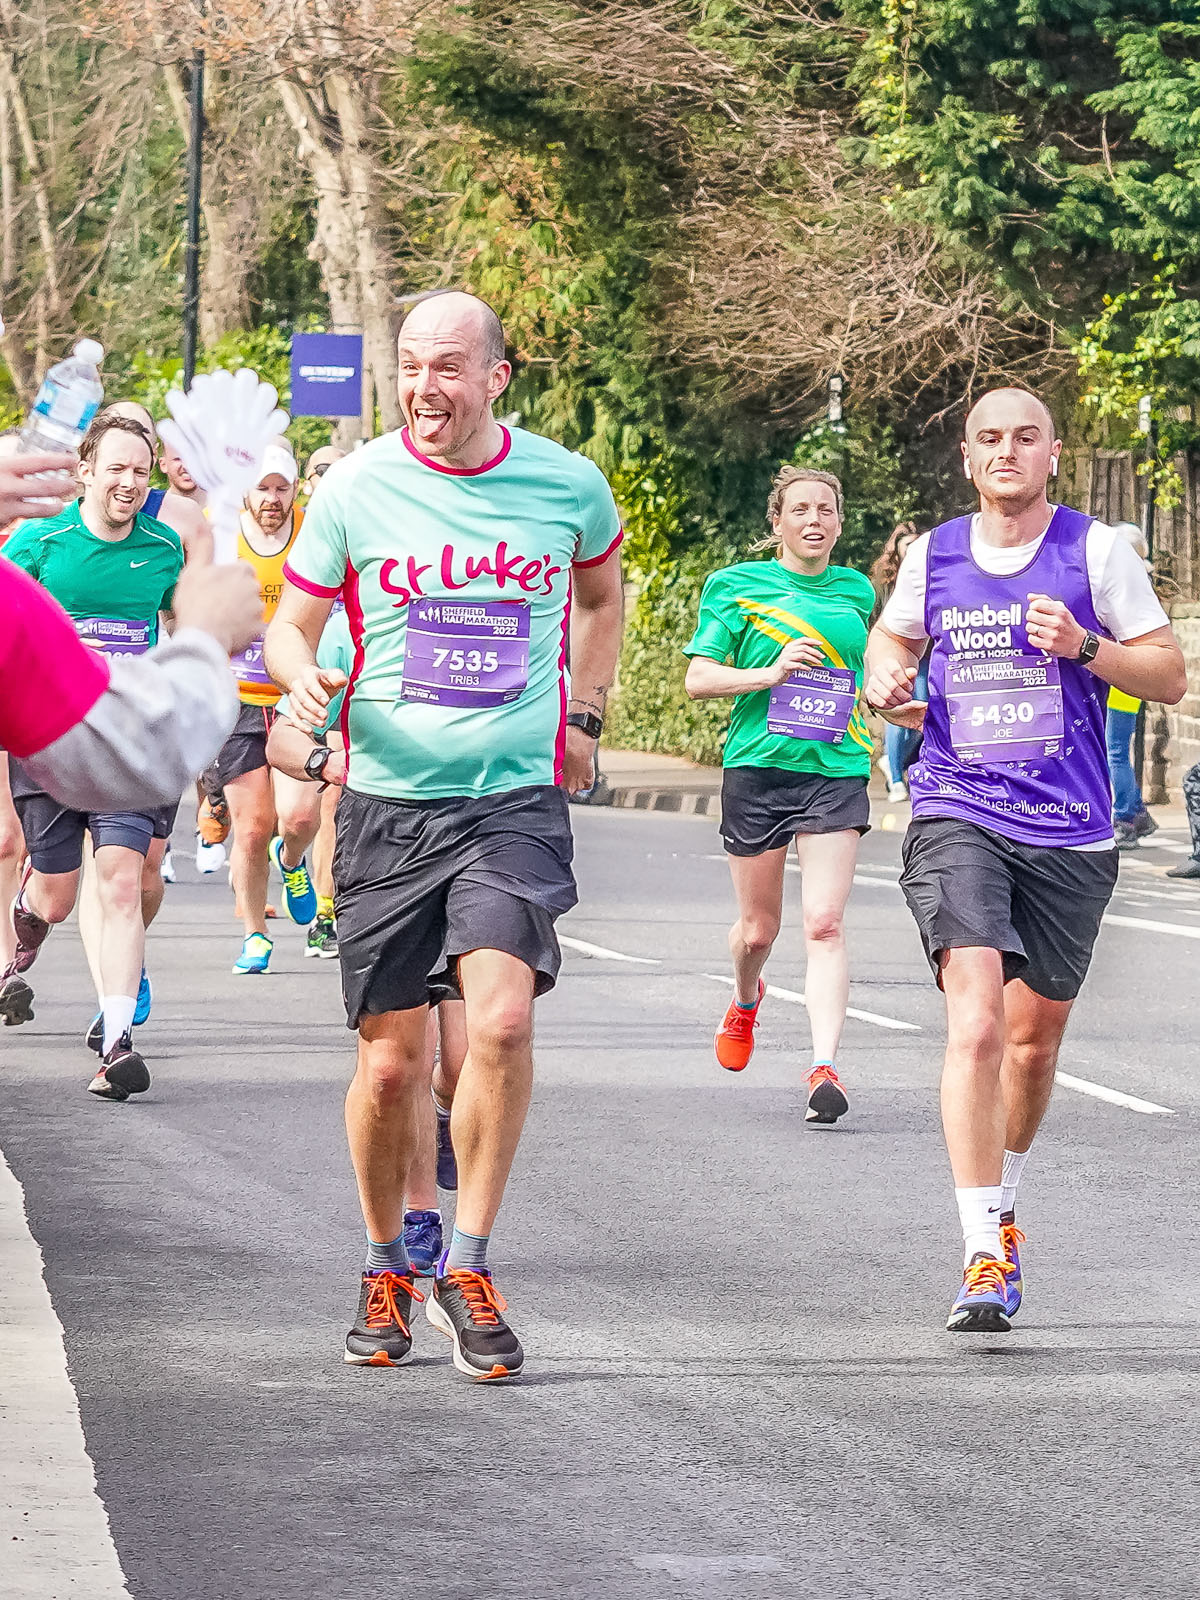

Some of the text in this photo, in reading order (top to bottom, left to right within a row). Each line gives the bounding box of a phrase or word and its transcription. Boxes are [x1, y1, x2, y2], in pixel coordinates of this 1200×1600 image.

[380, 541, 561, 608] St Luke's
[264, 584, 284, 593] CIT
[443, 607, 484, 616] SHEFFIELD
[442, 616, 517, 626] HALF MARATHON
[941, 604, 1022, 631] Bluebell
[492, 626, 518, 636] 2022
[950, 626, 1012, 651] Wood
[987, 649, 1023, 658] HOSPICE
[432, 647, 499, 673] 7535
[973, 663, 1013, 673] SHEFFIELD
[995, 668, 1046, 679] MARATHON
[448, 675, 480, 686] TRIB3
[1023, 677, 1047, 686] 2022
[789, 695, 836, 717] 4622
[798, 714, 824, 724] SARAH
[970, 701, 1034, 727] 5430
[992, 727, 1013, 738] JOE
